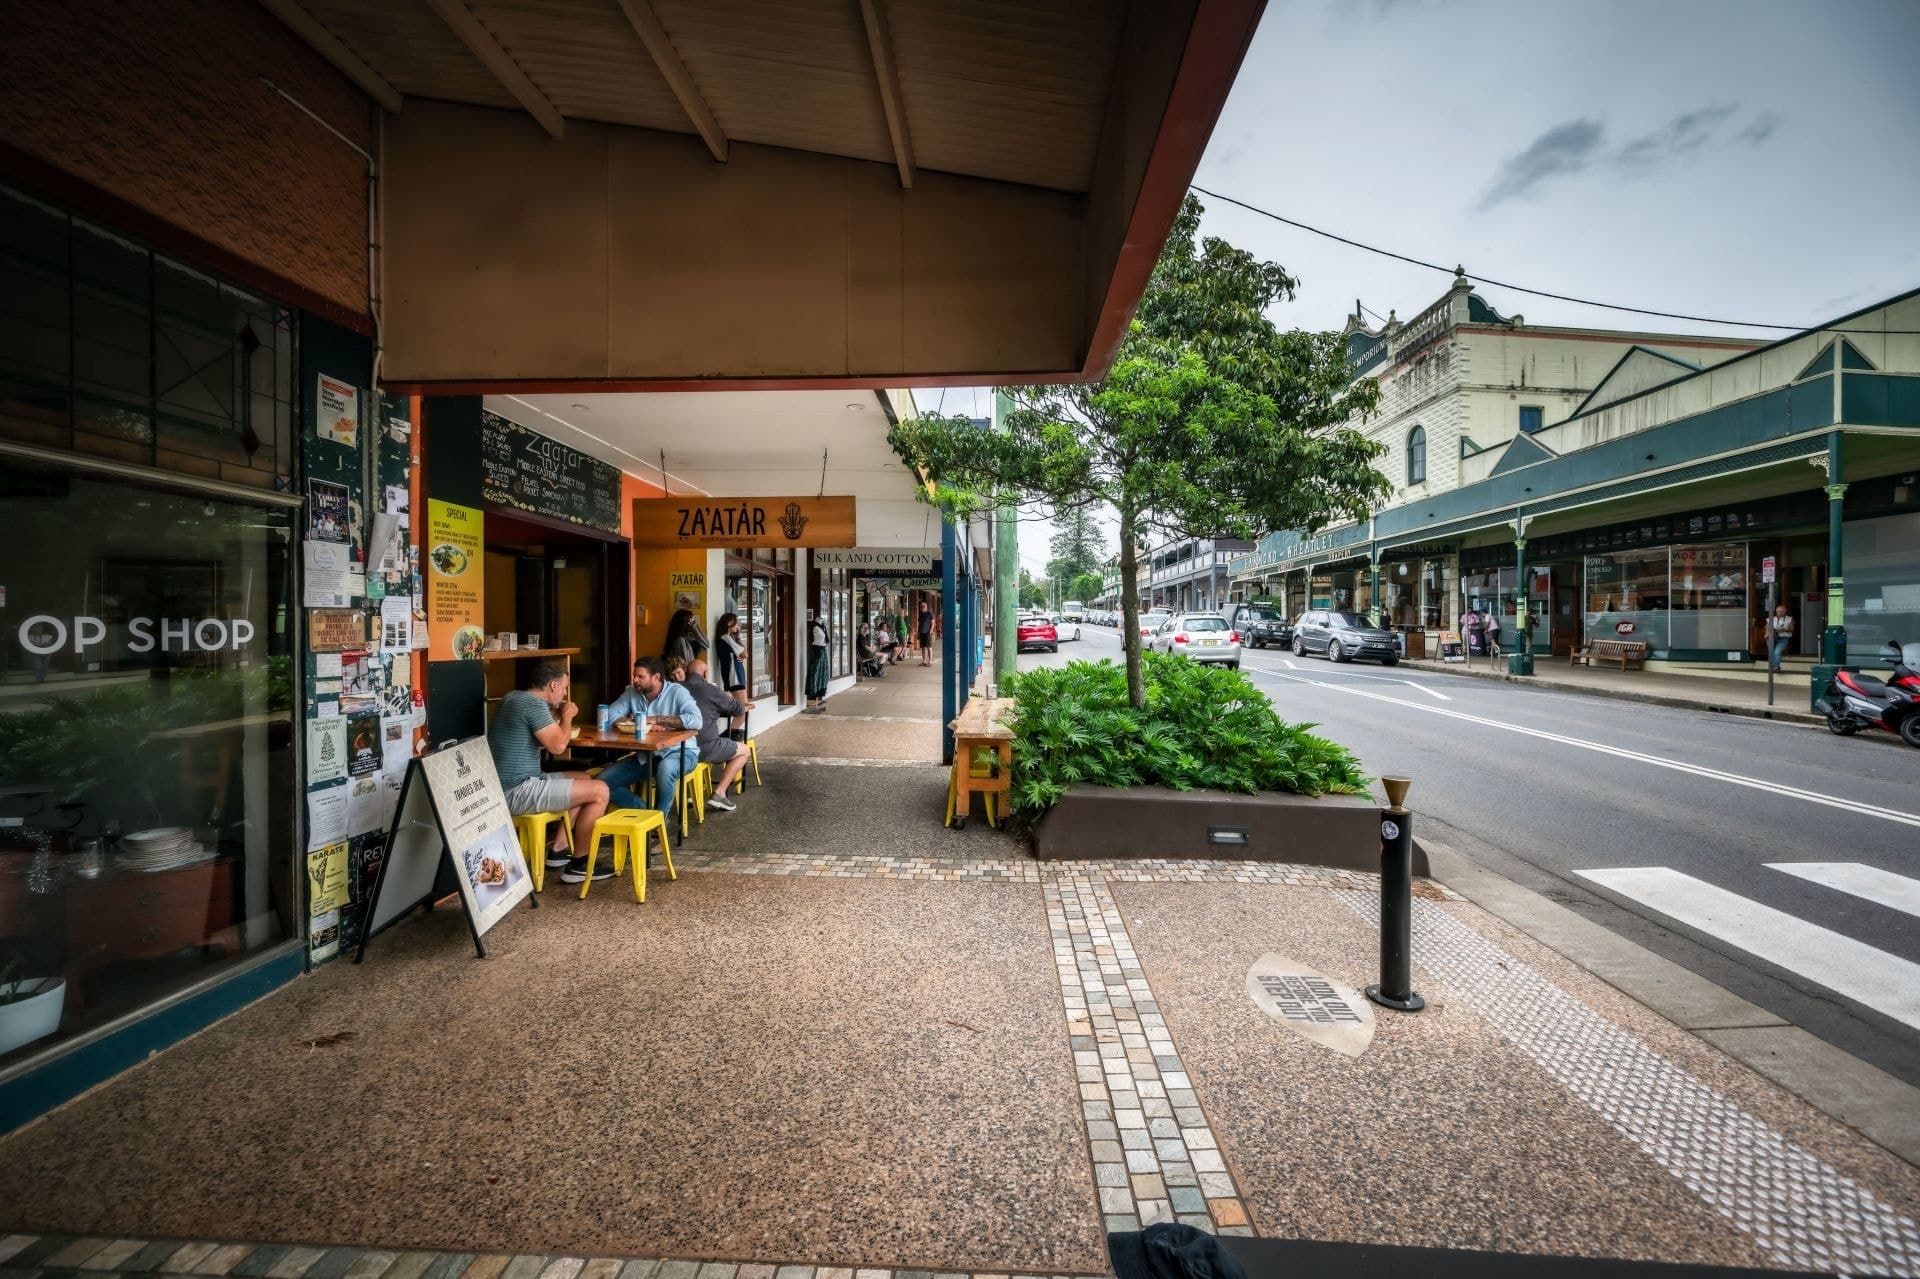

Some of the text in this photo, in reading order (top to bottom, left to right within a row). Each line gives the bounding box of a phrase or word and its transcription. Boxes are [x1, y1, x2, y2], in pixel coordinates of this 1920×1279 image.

[447, 508, 467, 521] SPECIAL
[1287, 535, 1333, 557] WHEATLEY
[816, 553, 930, 564] SILK AND COTTON
[1618, 624, 1633, 632] IGA
[454, 779, 485, 801] TRADIES DEAL
[312, 845, 344, 861] KARATE
[1257, 976, 1295, 999] STEP
[1282, 976, 1335, 1022] BEFORE YOU
[1300, 976, 1363, 1023] LOOK OUT
